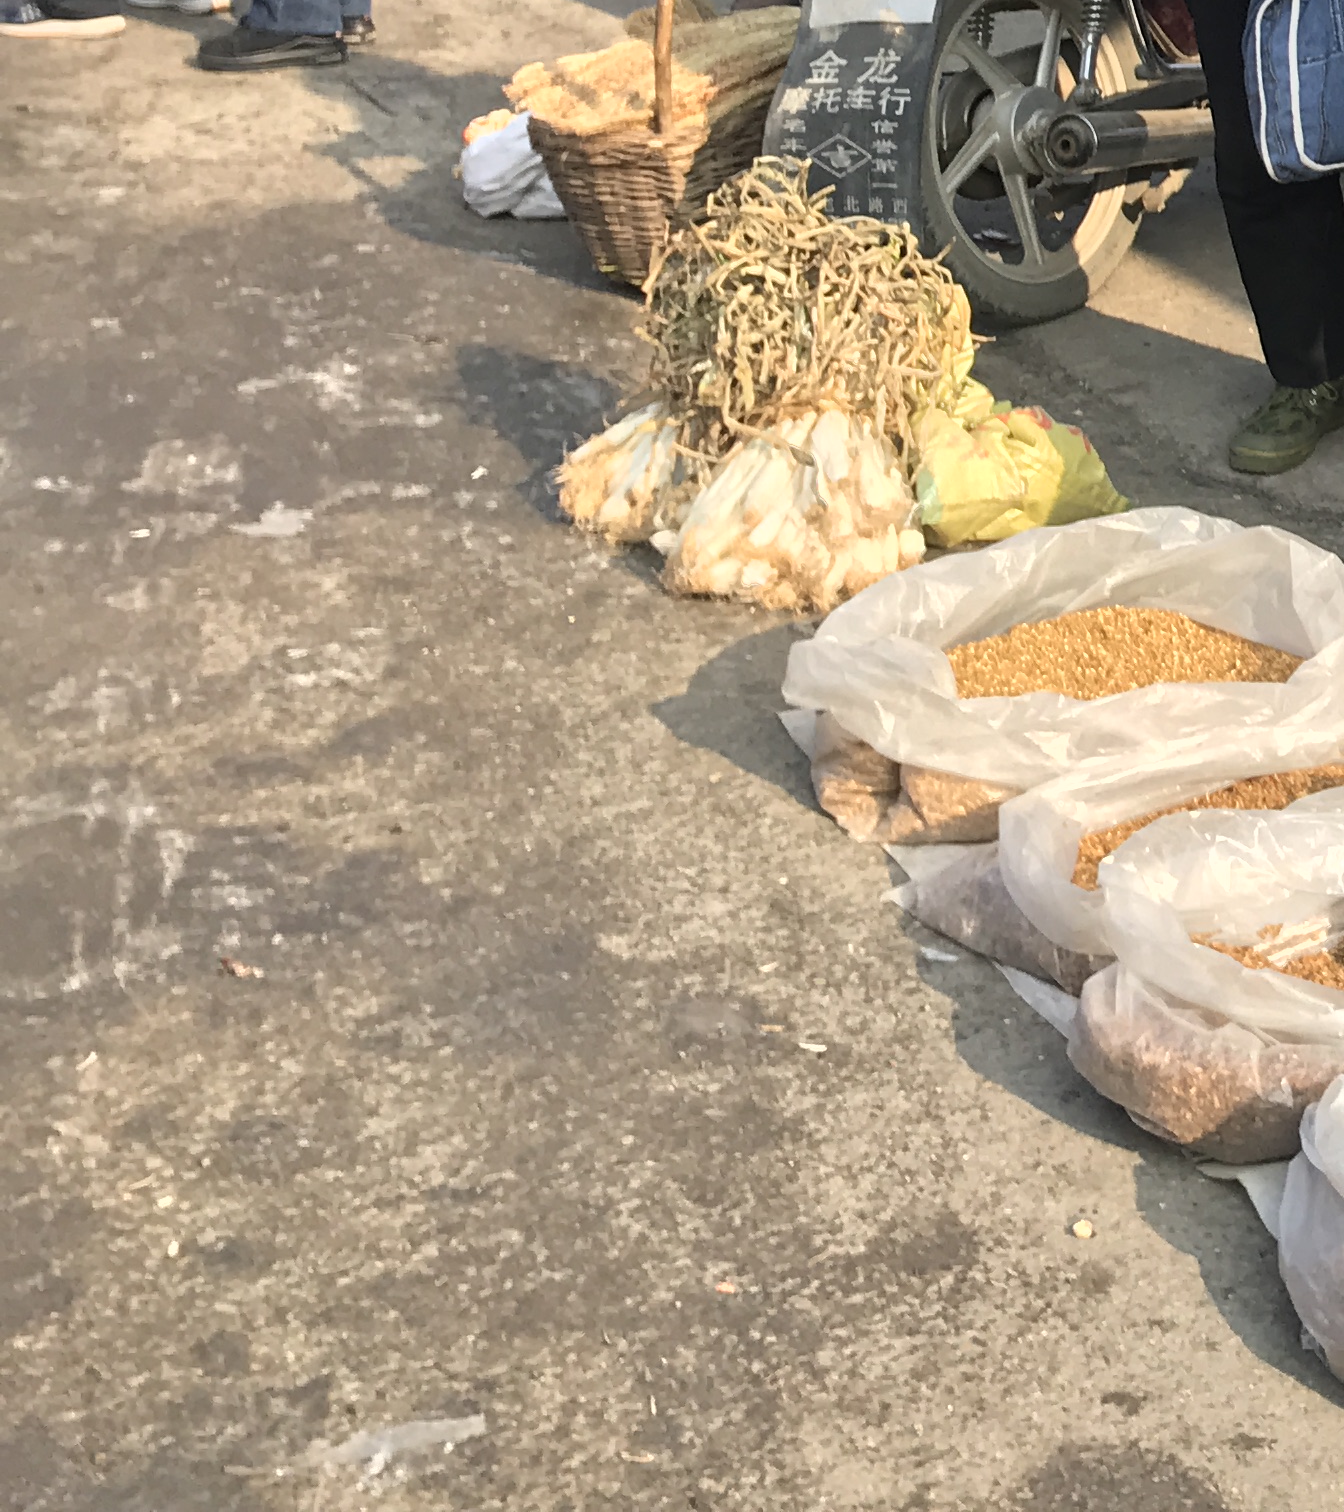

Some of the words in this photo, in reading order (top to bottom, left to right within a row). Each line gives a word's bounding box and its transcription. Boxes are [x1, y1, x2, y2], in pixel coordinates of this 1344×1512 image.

[804, 47, 902, 84] 金龙
[776, 86, 912, 116] 摩托车行
